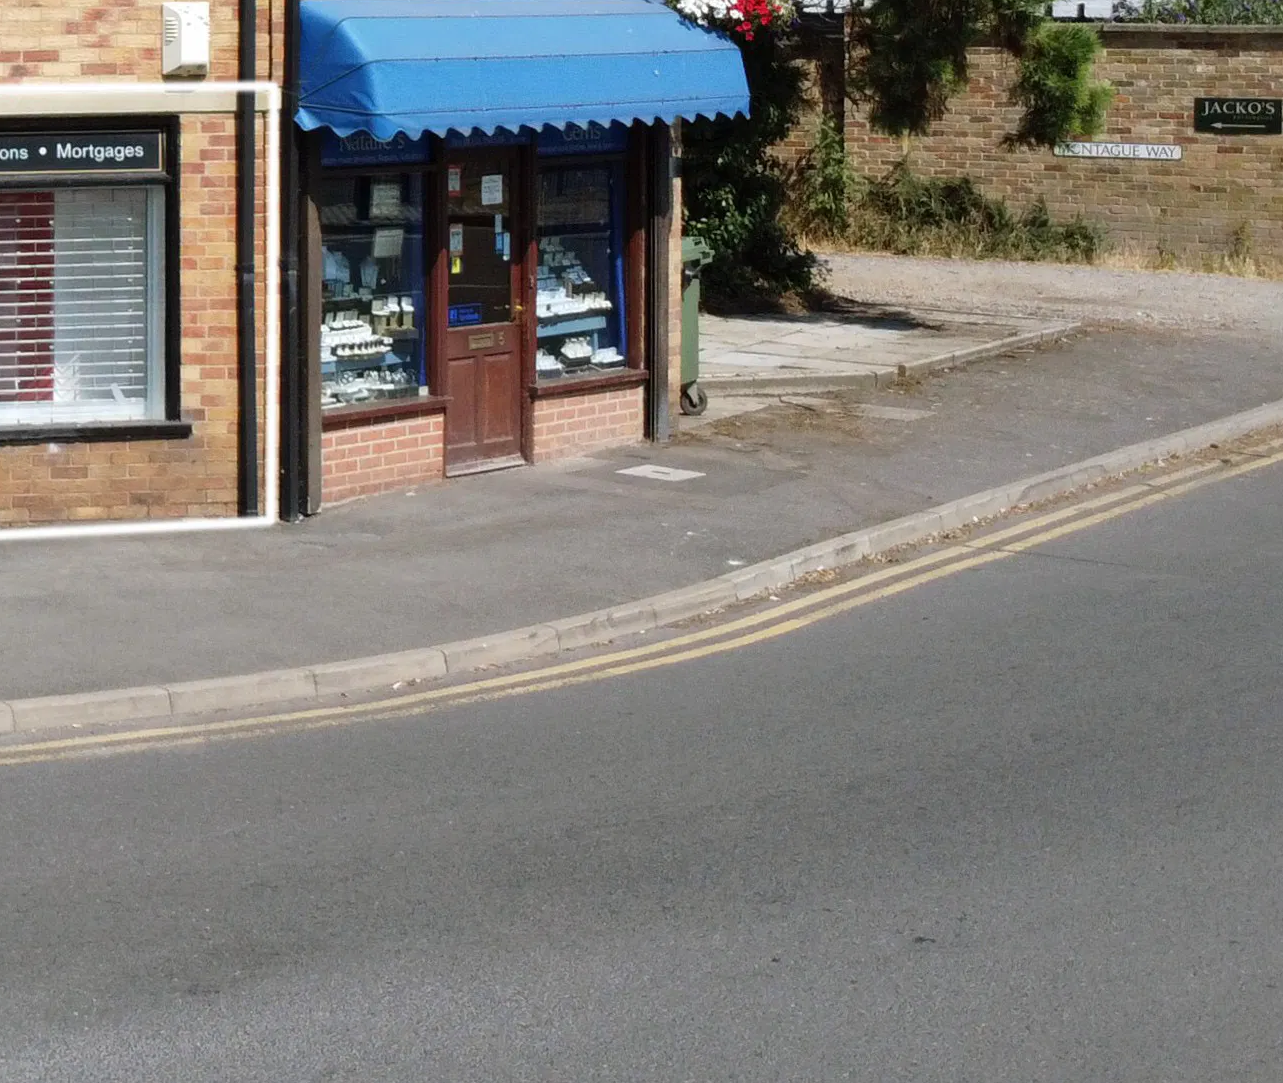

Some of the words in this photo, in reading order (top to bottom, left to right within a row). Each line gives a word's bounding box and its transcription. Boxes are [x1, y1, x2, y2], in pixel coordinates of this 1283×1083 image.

[1201, 101, 1275, 116] JACKO'S
[56, 142, 144, 162] Mortgages
[1145, 146, 1175, 158] WAY
